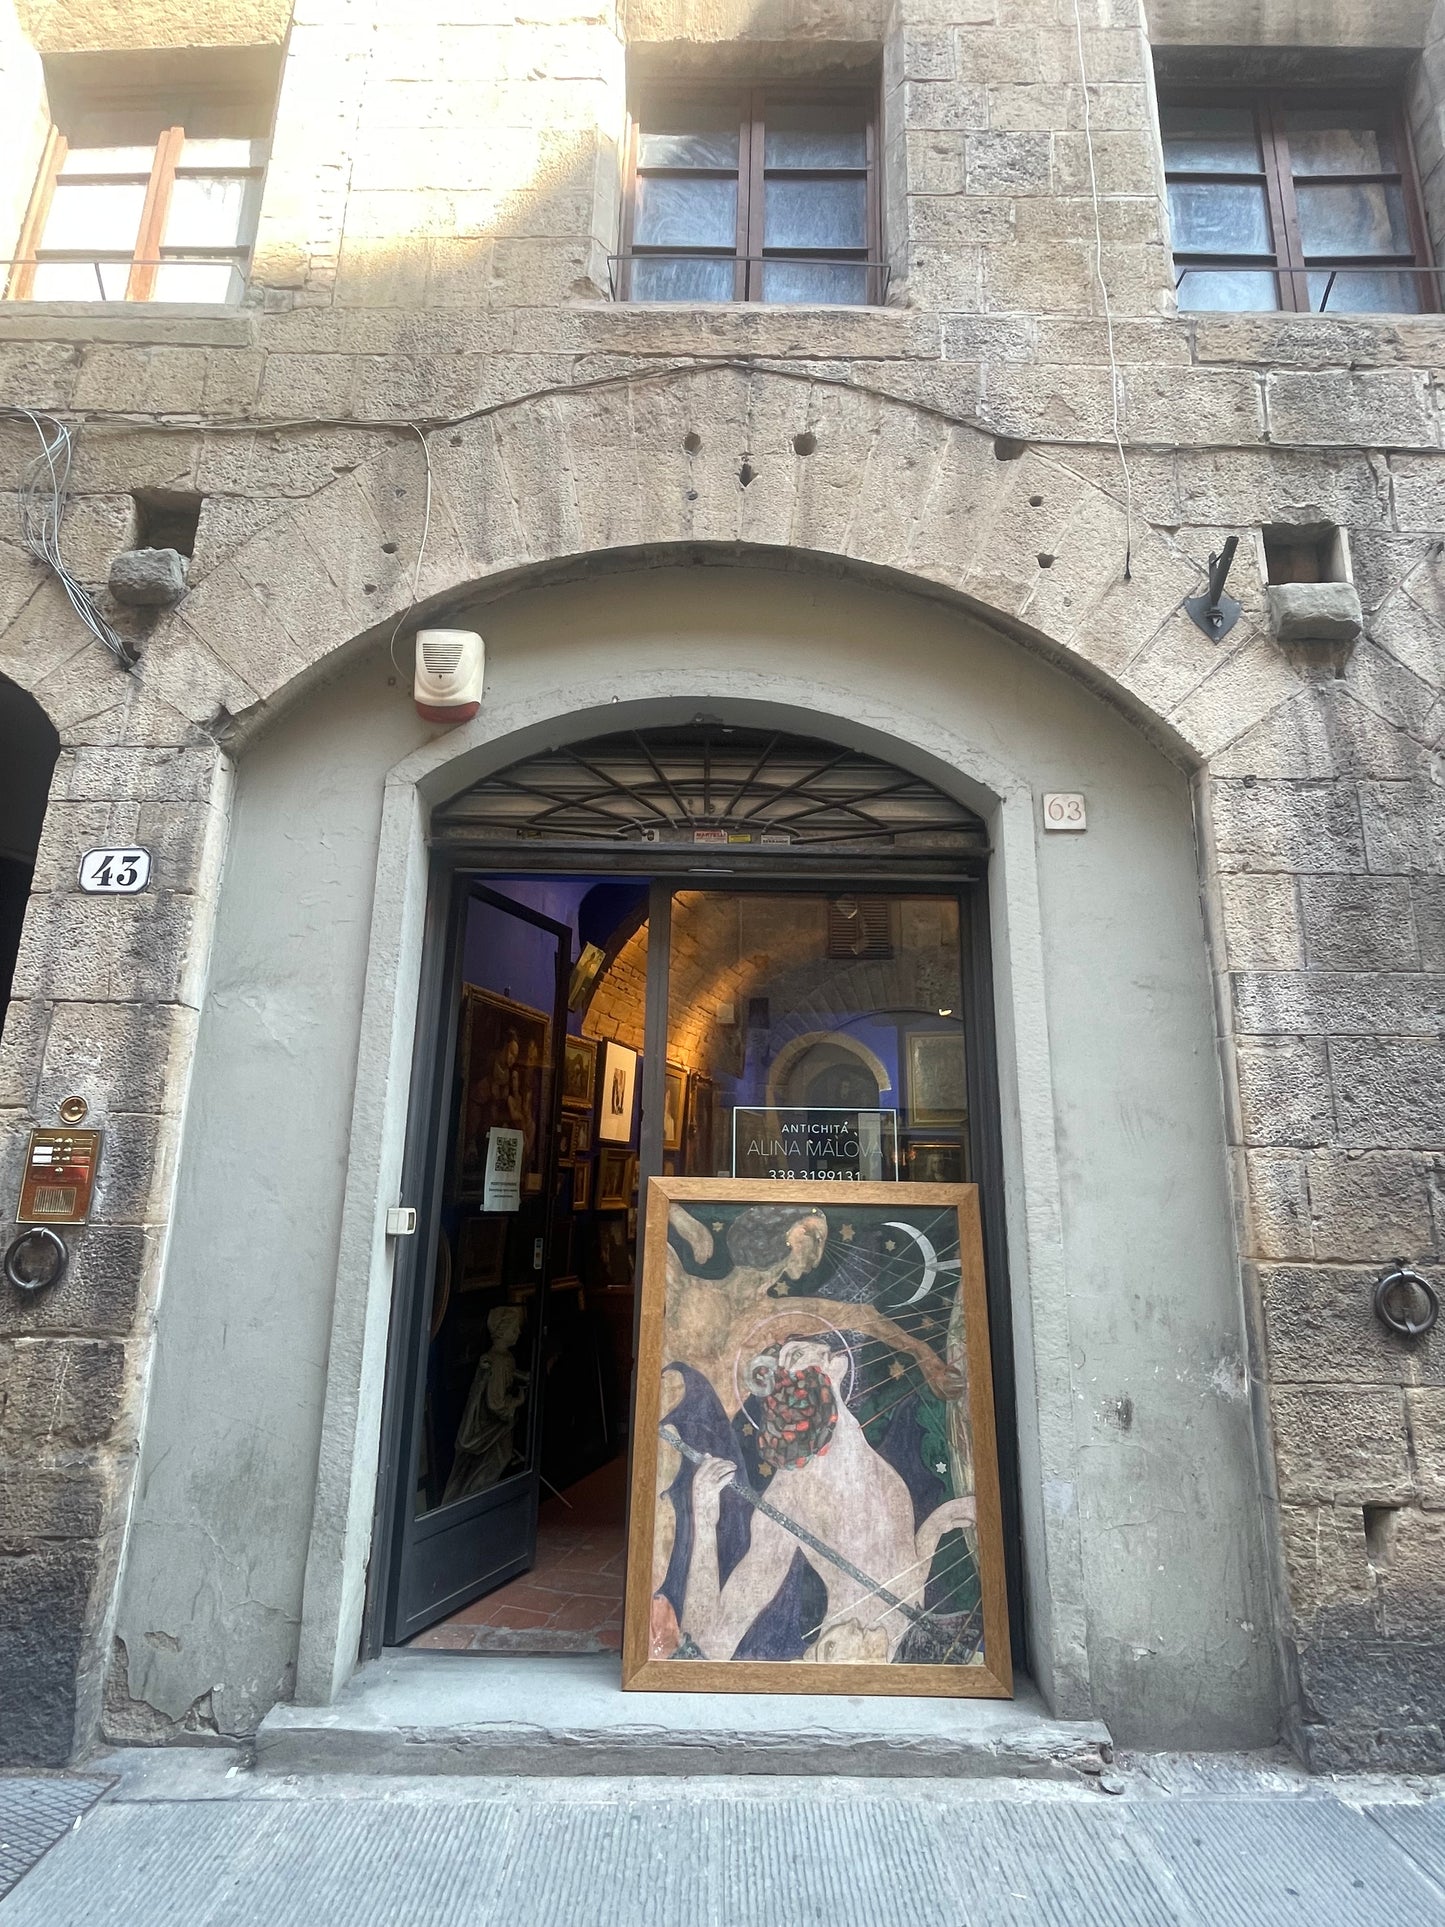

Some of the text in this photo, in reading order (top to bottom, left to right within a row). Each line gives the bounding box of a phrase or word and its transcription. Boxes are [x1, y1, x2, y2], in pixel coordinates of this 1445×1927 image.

[1048, 796, 1082, 821] 63
[91, 855, 141, 886] 43
[747, 1139, 801, 1157] ALINA
